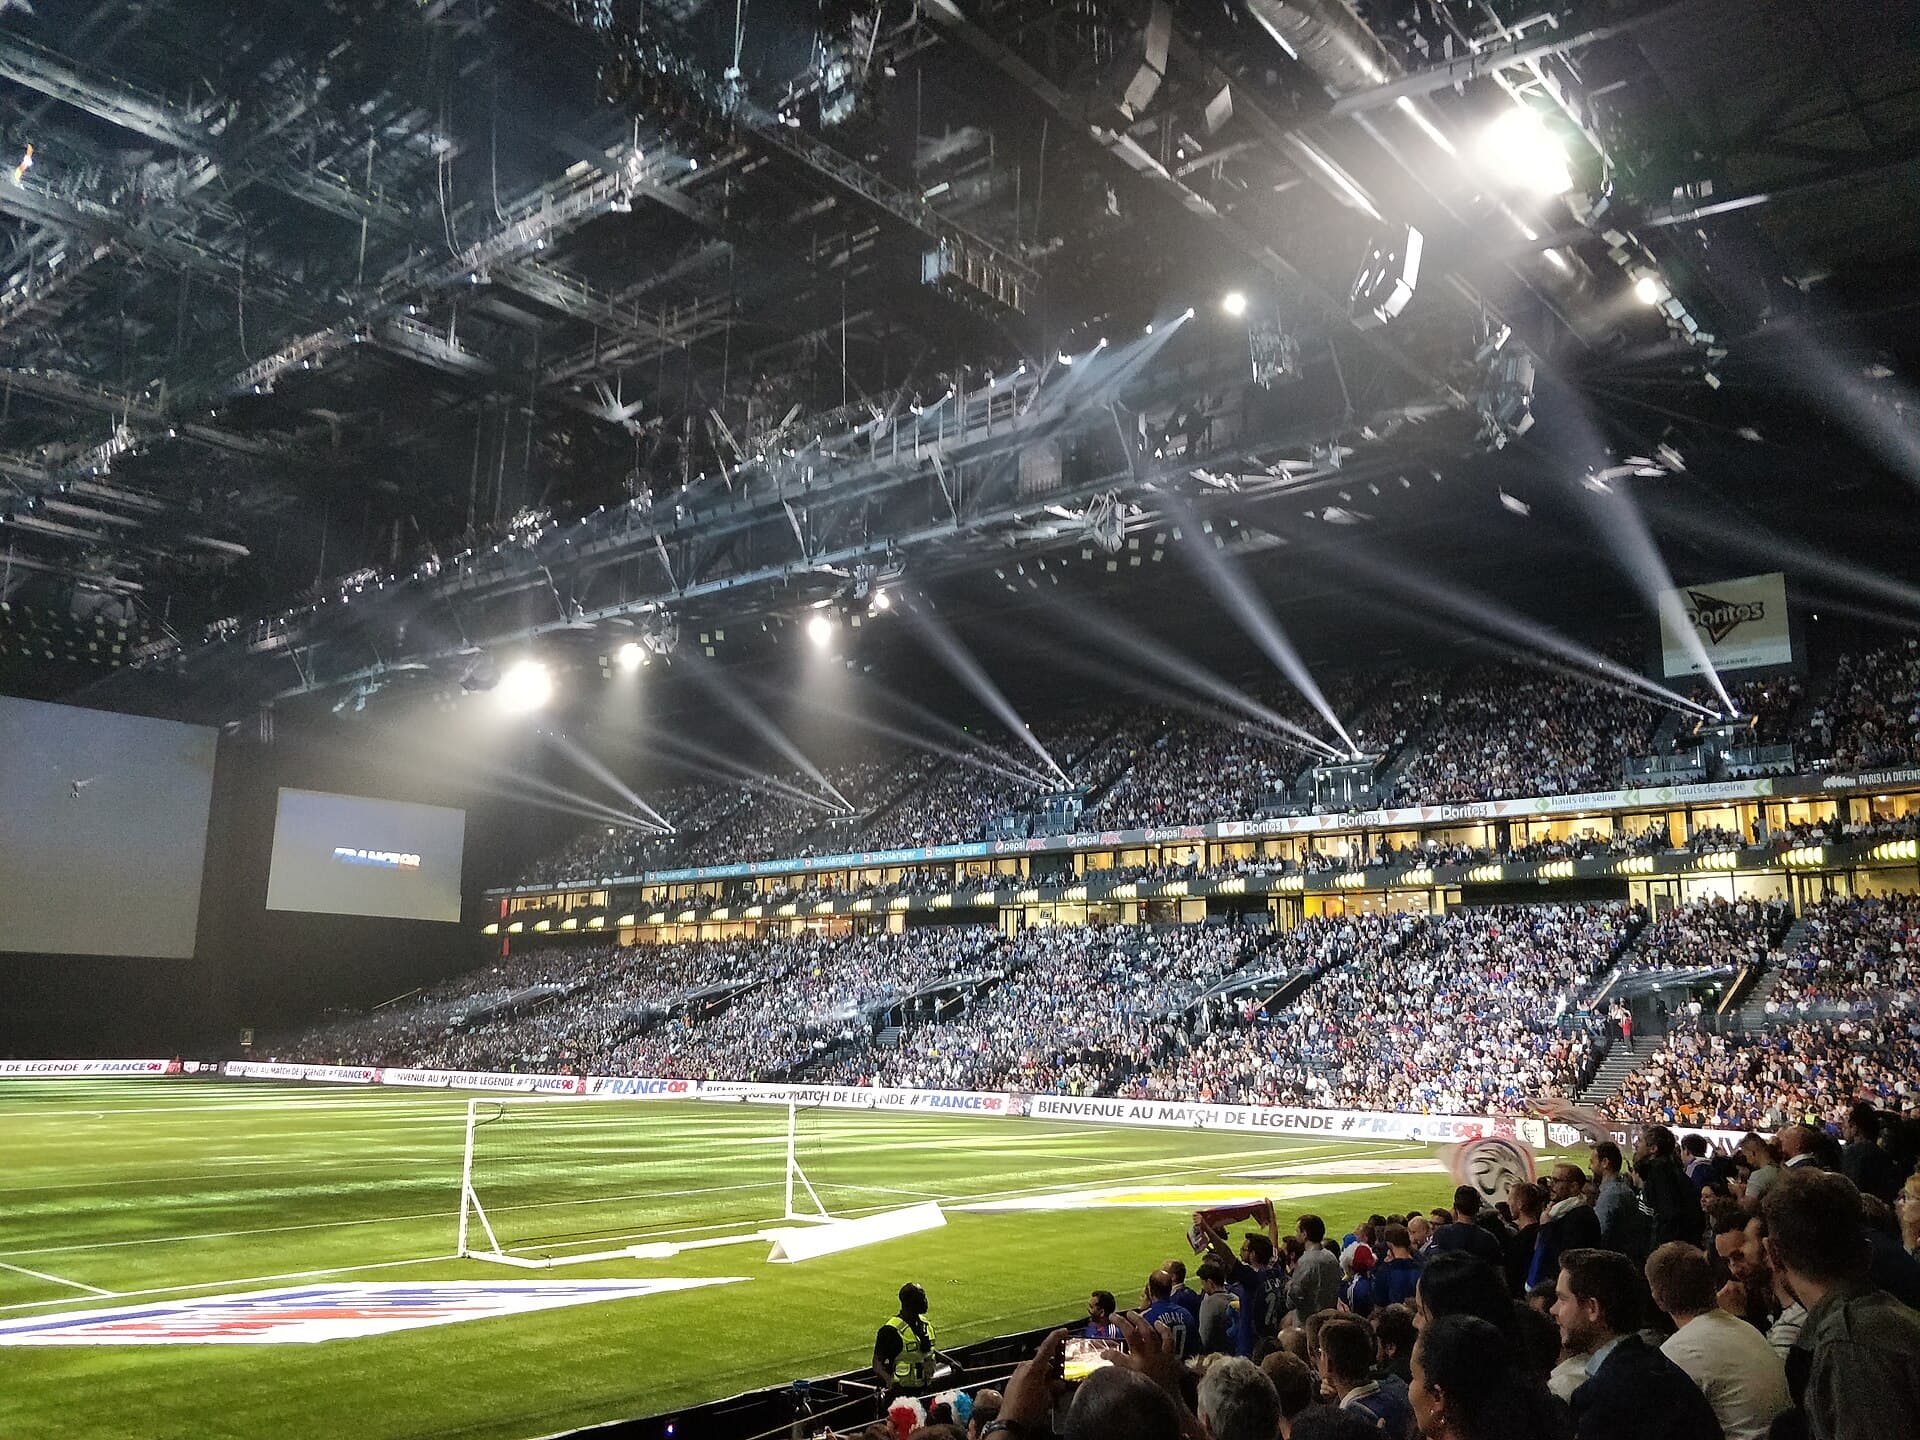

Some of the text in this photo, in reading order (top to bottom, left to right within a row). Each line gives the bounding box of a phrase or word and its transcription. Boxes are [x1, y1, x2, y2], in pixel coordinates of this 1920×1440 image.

[1859, 773, 1881, 785] PARIS
[1882, 771, 1892, 783] LA
[1675, 783, 1746, 796] hauts de seine
[1551, 793, 1617, 806] hauts de seine
[1441, 804, 1487, 820] Doritos
[1338, 812, 1380, 828] Doritos
[1244, 821, 1282, 834] Doritos
[1076, 834, 1099, 848] pepsi
[1155, 828, 1180, 841] pepsi
[936, 844, 982, 857] boulanger
[1004, 841, 1025, 852] pepsi
[813, 855, 854, 866] boulanger
[873, 851, 916, 862] boulanger
[706, 866, 743, 875] boulanger
[759, 861, 797, 871] boulanger
[657, 870, 691, 880] boulanger
[6, 1064, 21, 1072] DE
[394, 1072, 425, 1082] NVENUE
[427, 1074, 439, 1082] AU
[469, 1077, 479, 1085] DE
[832, 1092, 848, 1103] DE
[1038, 1101, 1124, 1118] BIENVENUE
[1129, 1106, 1153, 1119] AU
[1158, 1107, 1219, 1123] MATCH
[1225, 1111, 1246, 1125] DE
[1252, 1108, 1334, 1130] LÉGENDE
